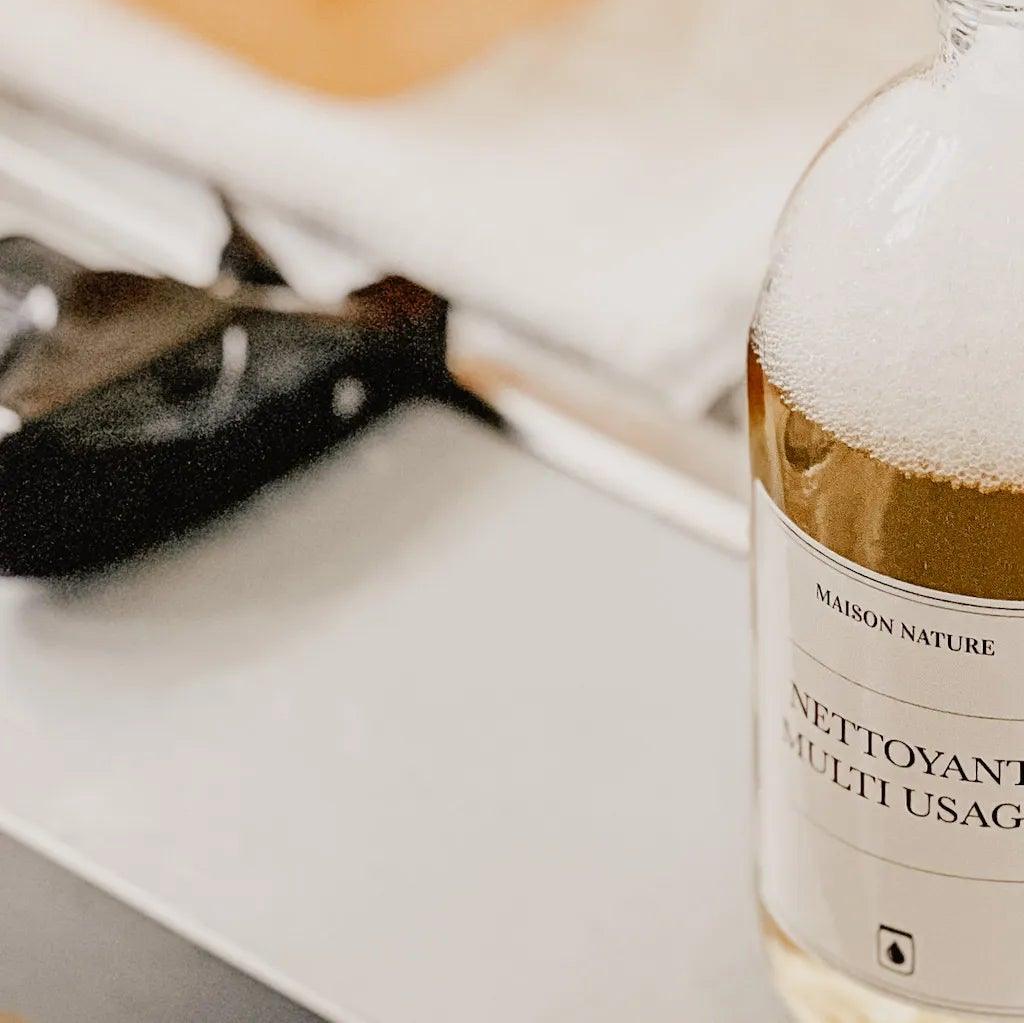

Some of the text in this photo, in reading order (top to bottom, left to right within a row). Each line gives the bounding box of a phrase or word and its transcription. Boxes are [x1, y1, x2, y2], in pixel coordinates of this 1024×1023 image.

[815, 583, 996, 656] MAISON NATURE
[782, 716, 890, 807] MULTI
